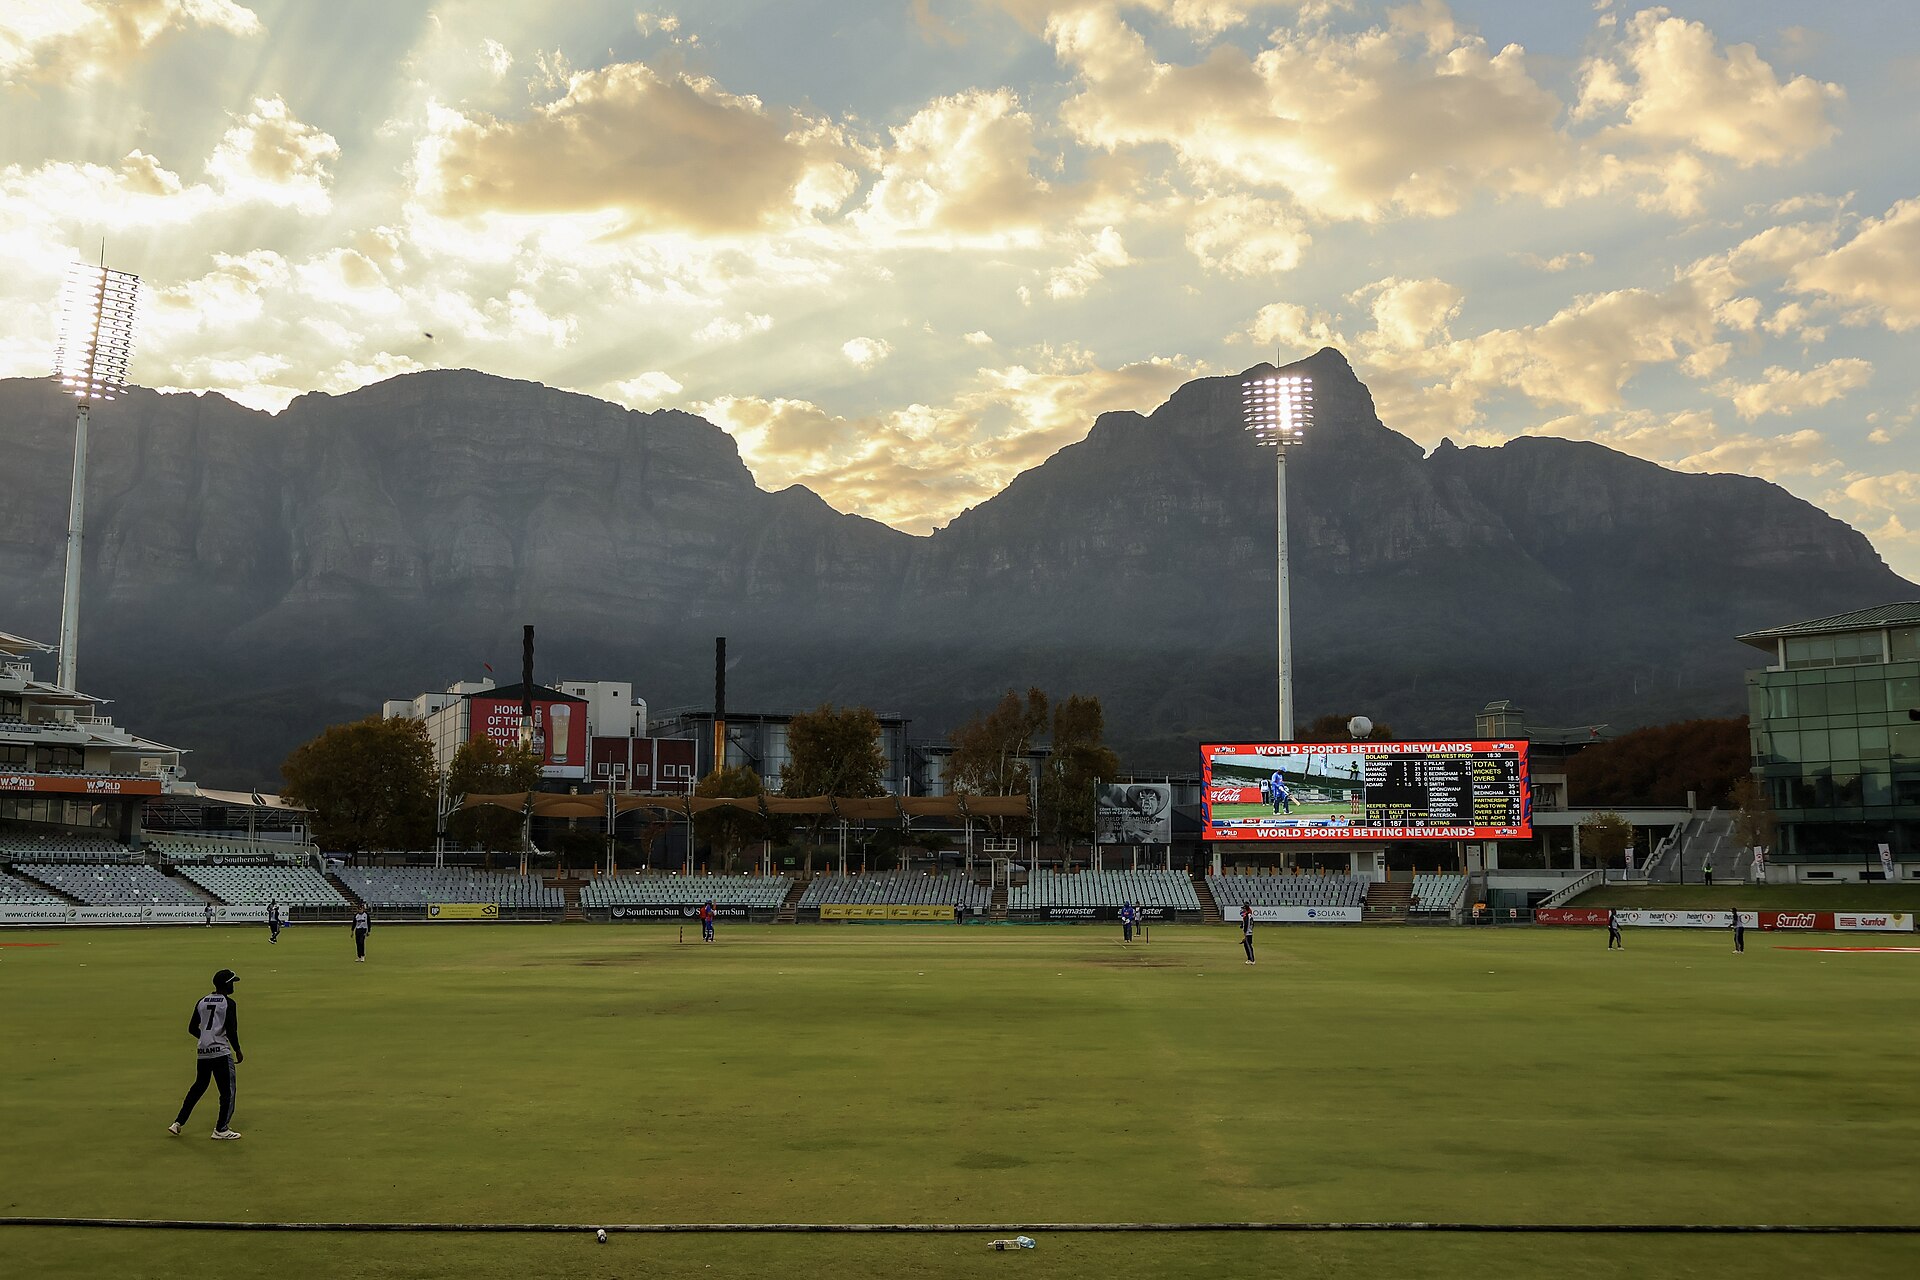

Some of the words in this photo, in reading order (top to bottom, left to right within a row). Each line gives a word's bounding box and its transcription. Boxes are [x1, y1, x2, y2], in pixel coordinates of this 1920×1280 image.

[494, 705, 523, 714] HOME
[488, 716, 502, 725] OF
[503, 717, 518, 726] TH
[1255, 746, 1299, 754] WORLD
[1302, 746, 1348, 754] SPORTS
[1350, 745, 1400, 753] BETTING
[1404, 744, 1472, 752] NEWLANDS
[1257, 829, 1301, 837] WORLD
[1304, 829, 1350, 837] SPORTS
[1353, 828, 1403, 837] BETTING
[1406, 827, 1475, 836] NEWLANDS
[231, 908, 289, 916] www.cricke.za
[1777, 913, 1815, 928] Sunfoil
[1861, 918, 1887, 926] Sunfoil
[206, 1005, 216, 1030] 7
